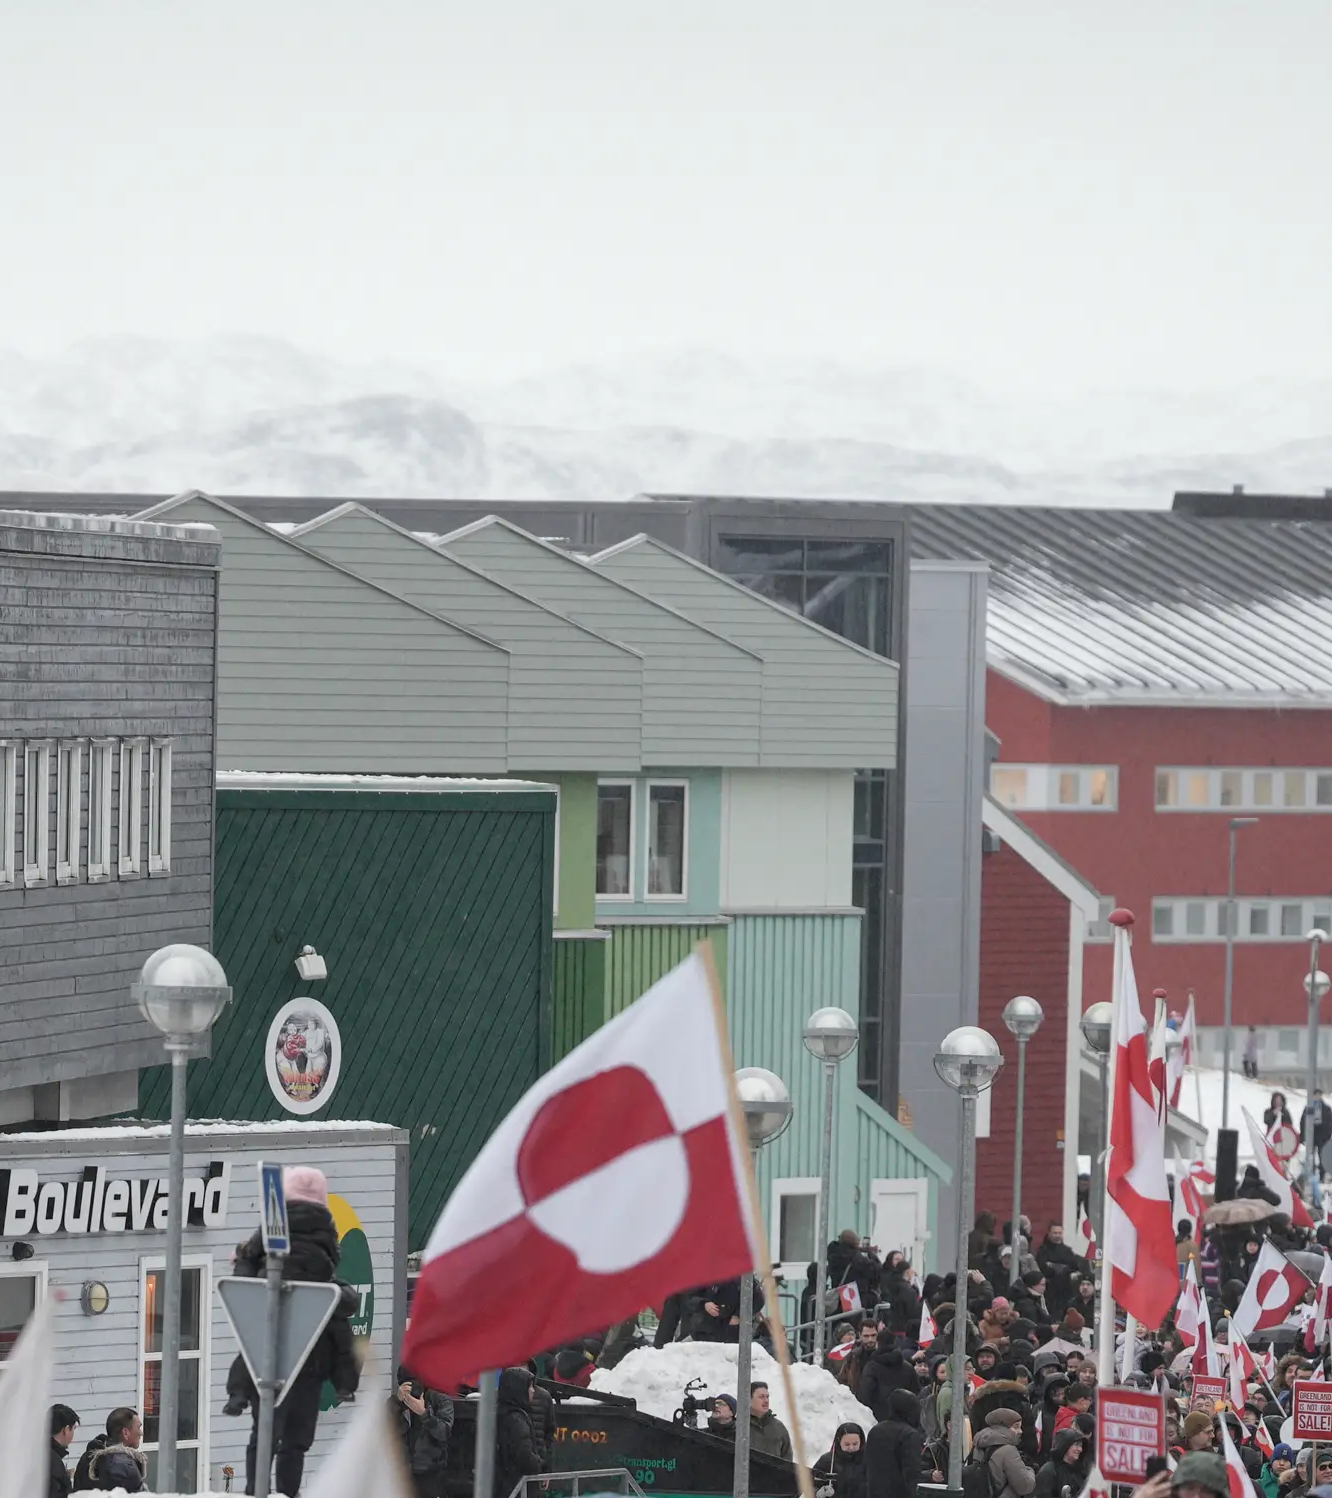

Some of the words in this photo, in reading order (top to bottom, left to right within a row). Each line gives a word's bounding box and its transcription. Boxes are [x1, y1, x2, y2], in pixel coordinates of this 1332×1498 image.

[1299, 1391, 1332, 1401] GREENLAND
[1299, 1403, 1305, 1411] IS
[1320, 1404, 1331, 1412] FOR
[1299, 1414, 1331, 1431] SALE!
